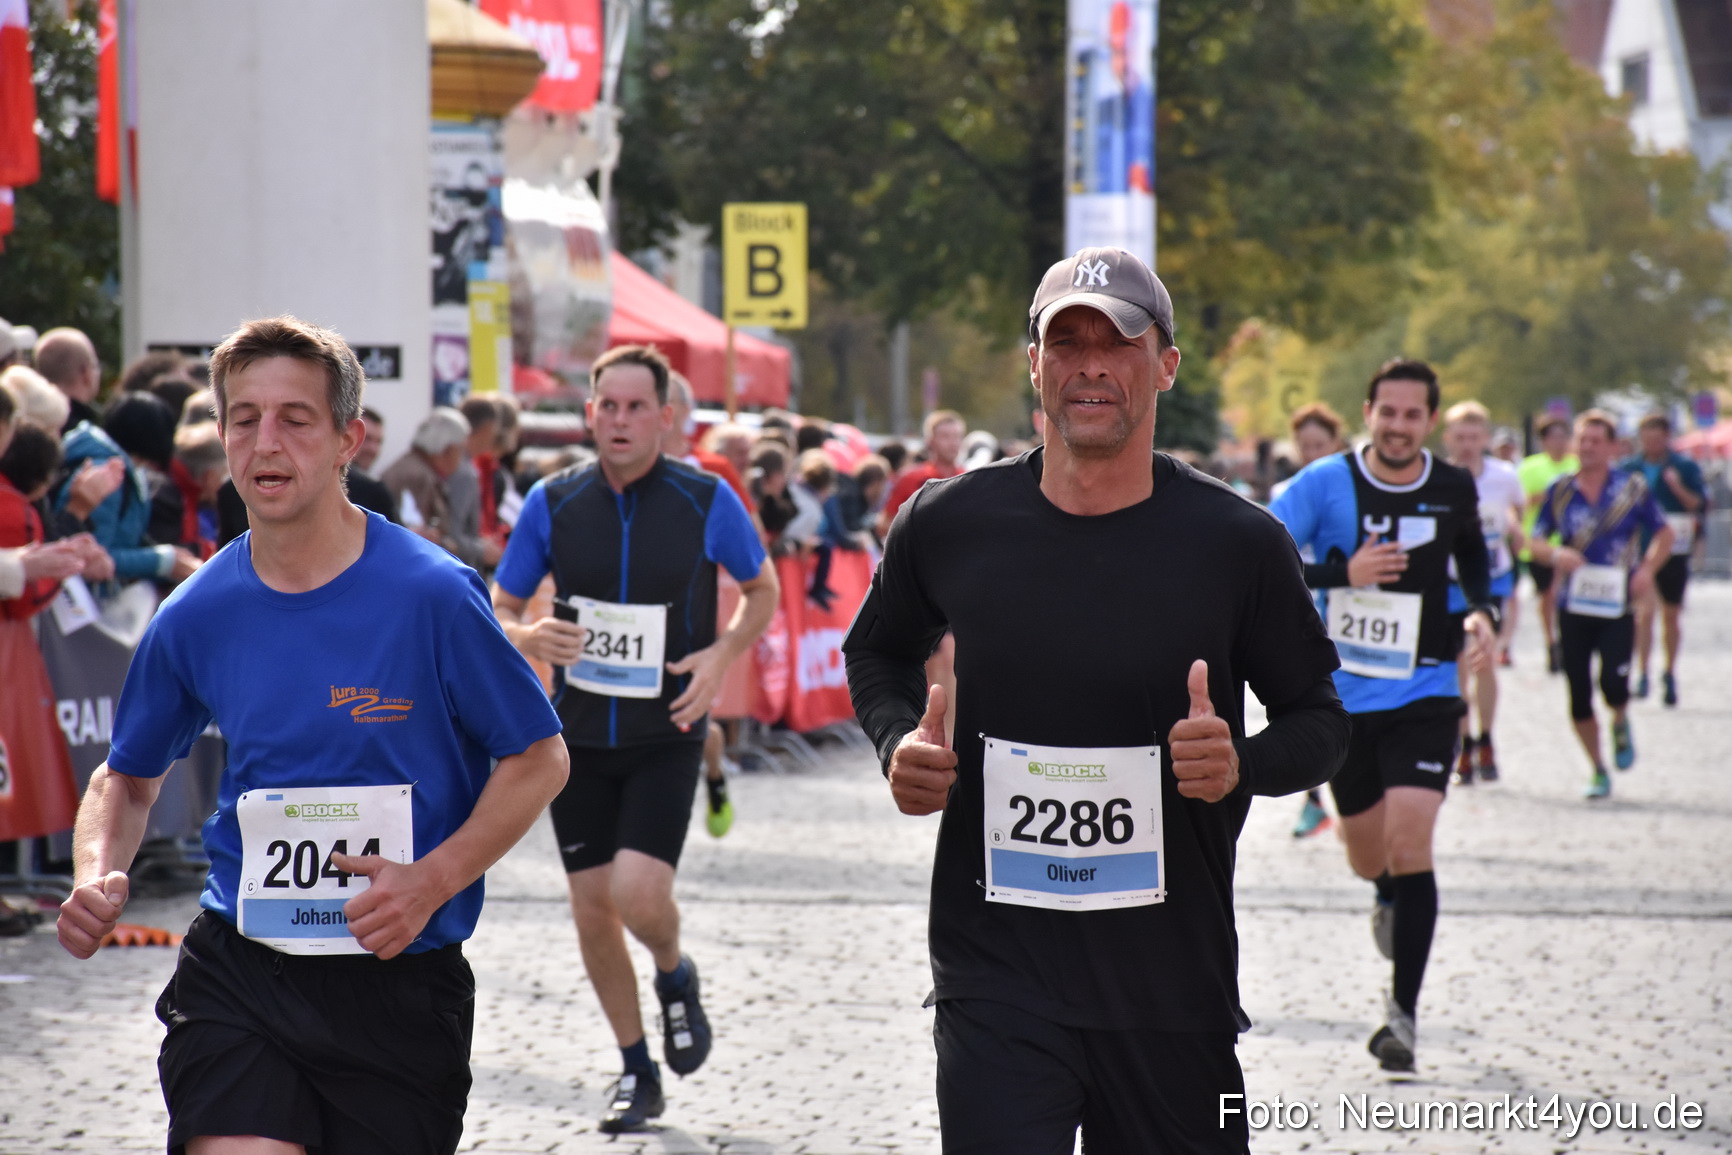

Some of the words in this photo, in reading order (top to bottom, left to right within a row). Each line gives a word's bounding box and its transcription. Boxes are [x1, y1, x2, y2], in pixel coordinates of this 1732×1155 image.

[734, 212, 794, 232] Block
[748, 244, 783, 298] B
[1074, 259, 1111, 287] NY
[1341, 613, 1399, 645] 2191
[583, 628, 643, 660] 2341
[330, 685, 357, 705] jura
[359, 687, 380, 695] 2000
[382, 697, 414, 706] Greding
[353, 714, 408, 723] Halbmarathon
[1045, 763, 1106, 777] BOCK
[301, 803, 359, 817] BOCK
[1009, 795, 1134, 847] 2286
[994, 832, 1001, 841] B
[1046, 863, 1097, 883] Oliver
[247, 882, 254, 892] C
